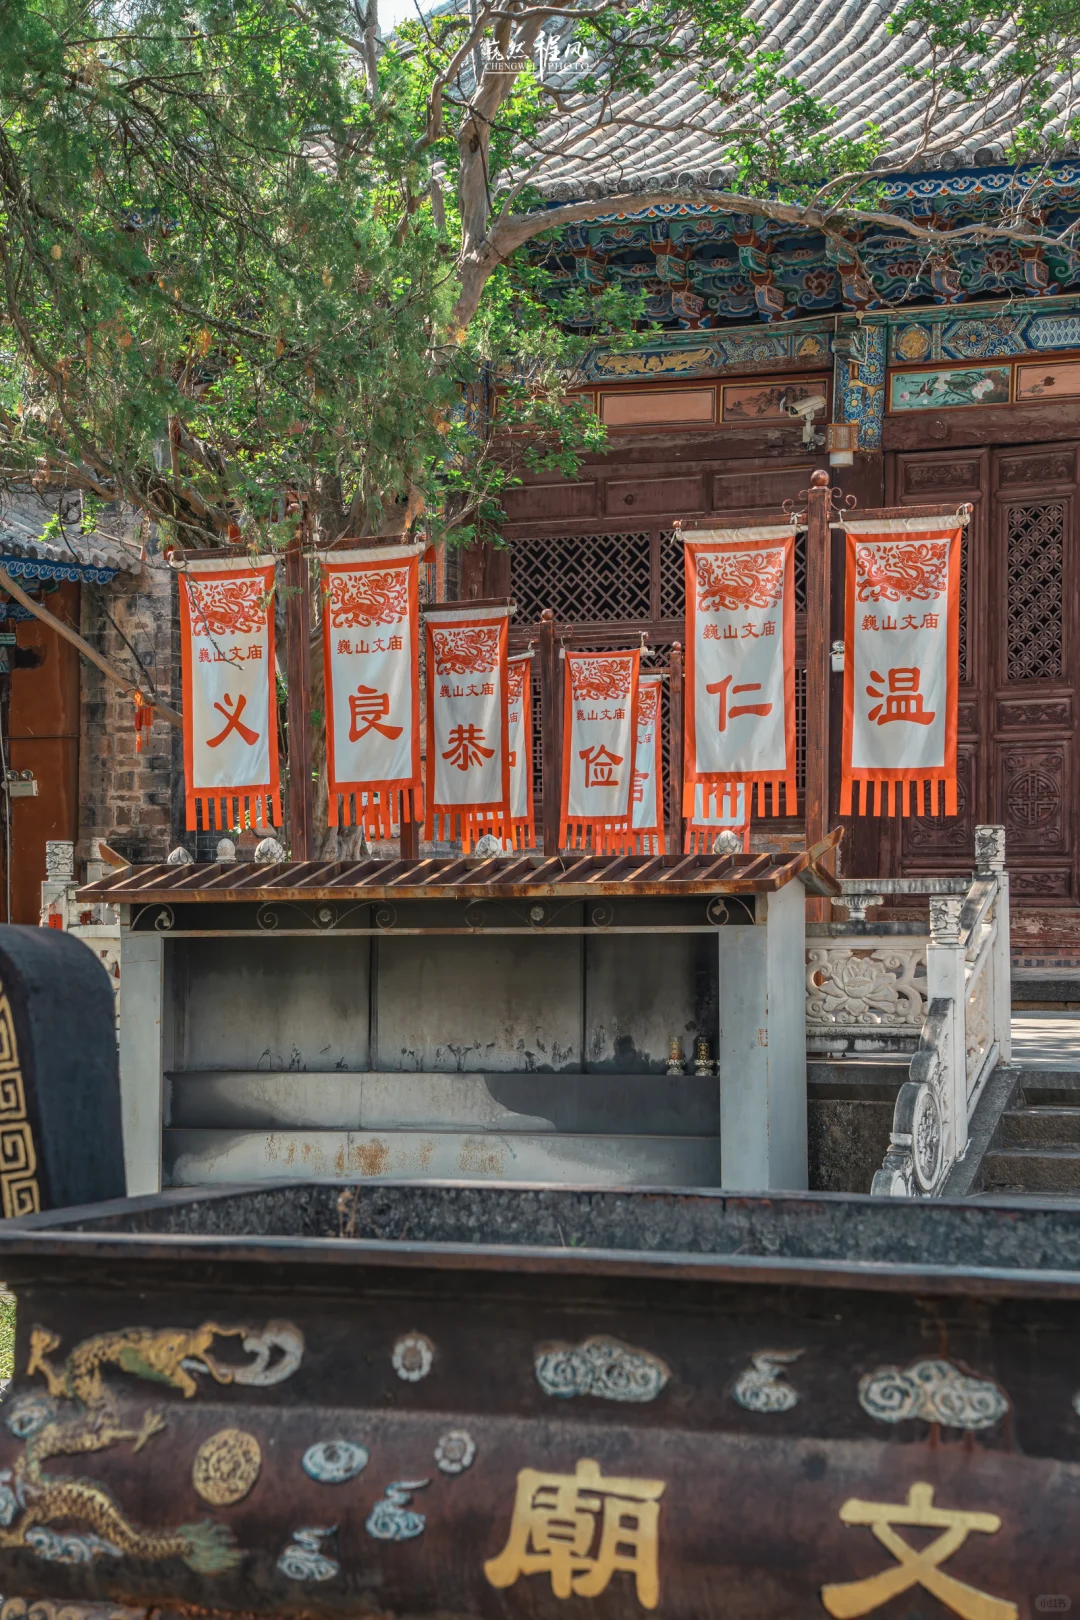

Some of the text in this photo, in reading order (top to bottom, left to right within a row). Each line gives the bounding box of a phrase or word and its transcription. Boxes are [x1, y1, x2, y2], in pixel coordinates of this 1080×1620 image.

[703, 620, 776, 640] 巍山文庙
[862, 612, 939, 632] 巍山文庙
[199, 644, 263, 663] 巍山文庙
[337, 635, 403, 655] 巍山文庙
[440, 682, 495, 698] 巍山文庙
[706, 674, 773, 732] 仁
[865, 666, 936, 726] 温
[206, 692, 260, 748] 义
[348, 684, 404, 743] 良
[576, 708, 625, 721] 巍山文庙
[442, 723, 495, 771] 恭
[579, 744, 624, 788] 俭
